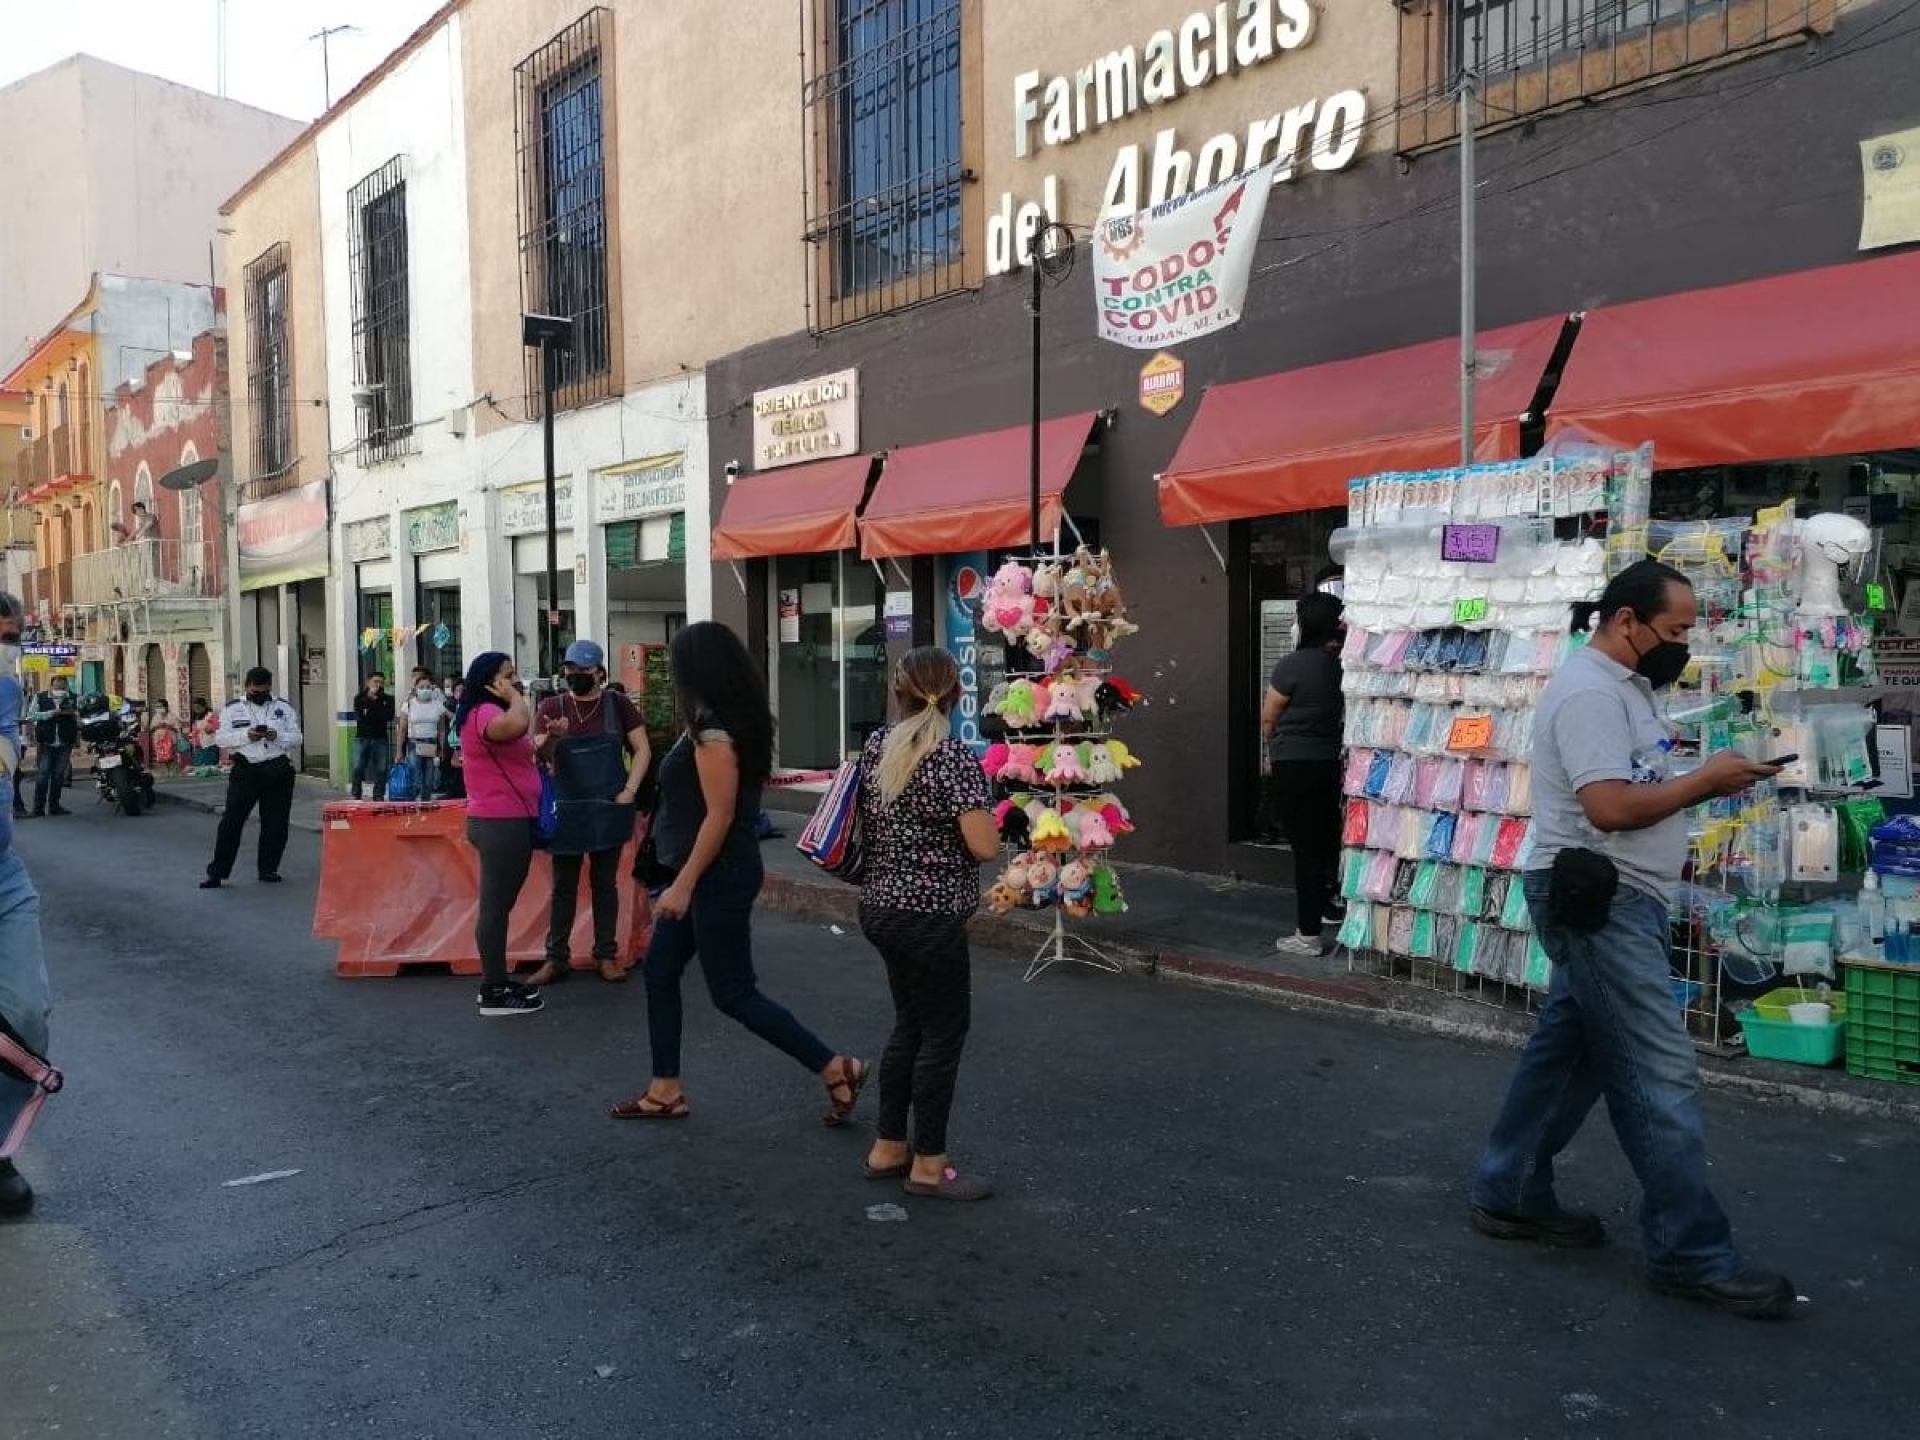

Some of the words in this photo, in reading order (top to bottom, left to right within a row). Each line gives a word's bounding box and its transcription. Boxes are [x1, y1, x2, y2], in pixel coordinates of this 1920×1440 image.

[1014, 0, 1317, 158] Farmacias
[986, 174, 1061, 276] del
[1103, 89, 1368, 219] Ahorro
[1103, 269, 1213, 311] CONTRA
[1103, 285, 1219, 331] COVID
[955, 634, 986, 746] pepsi
